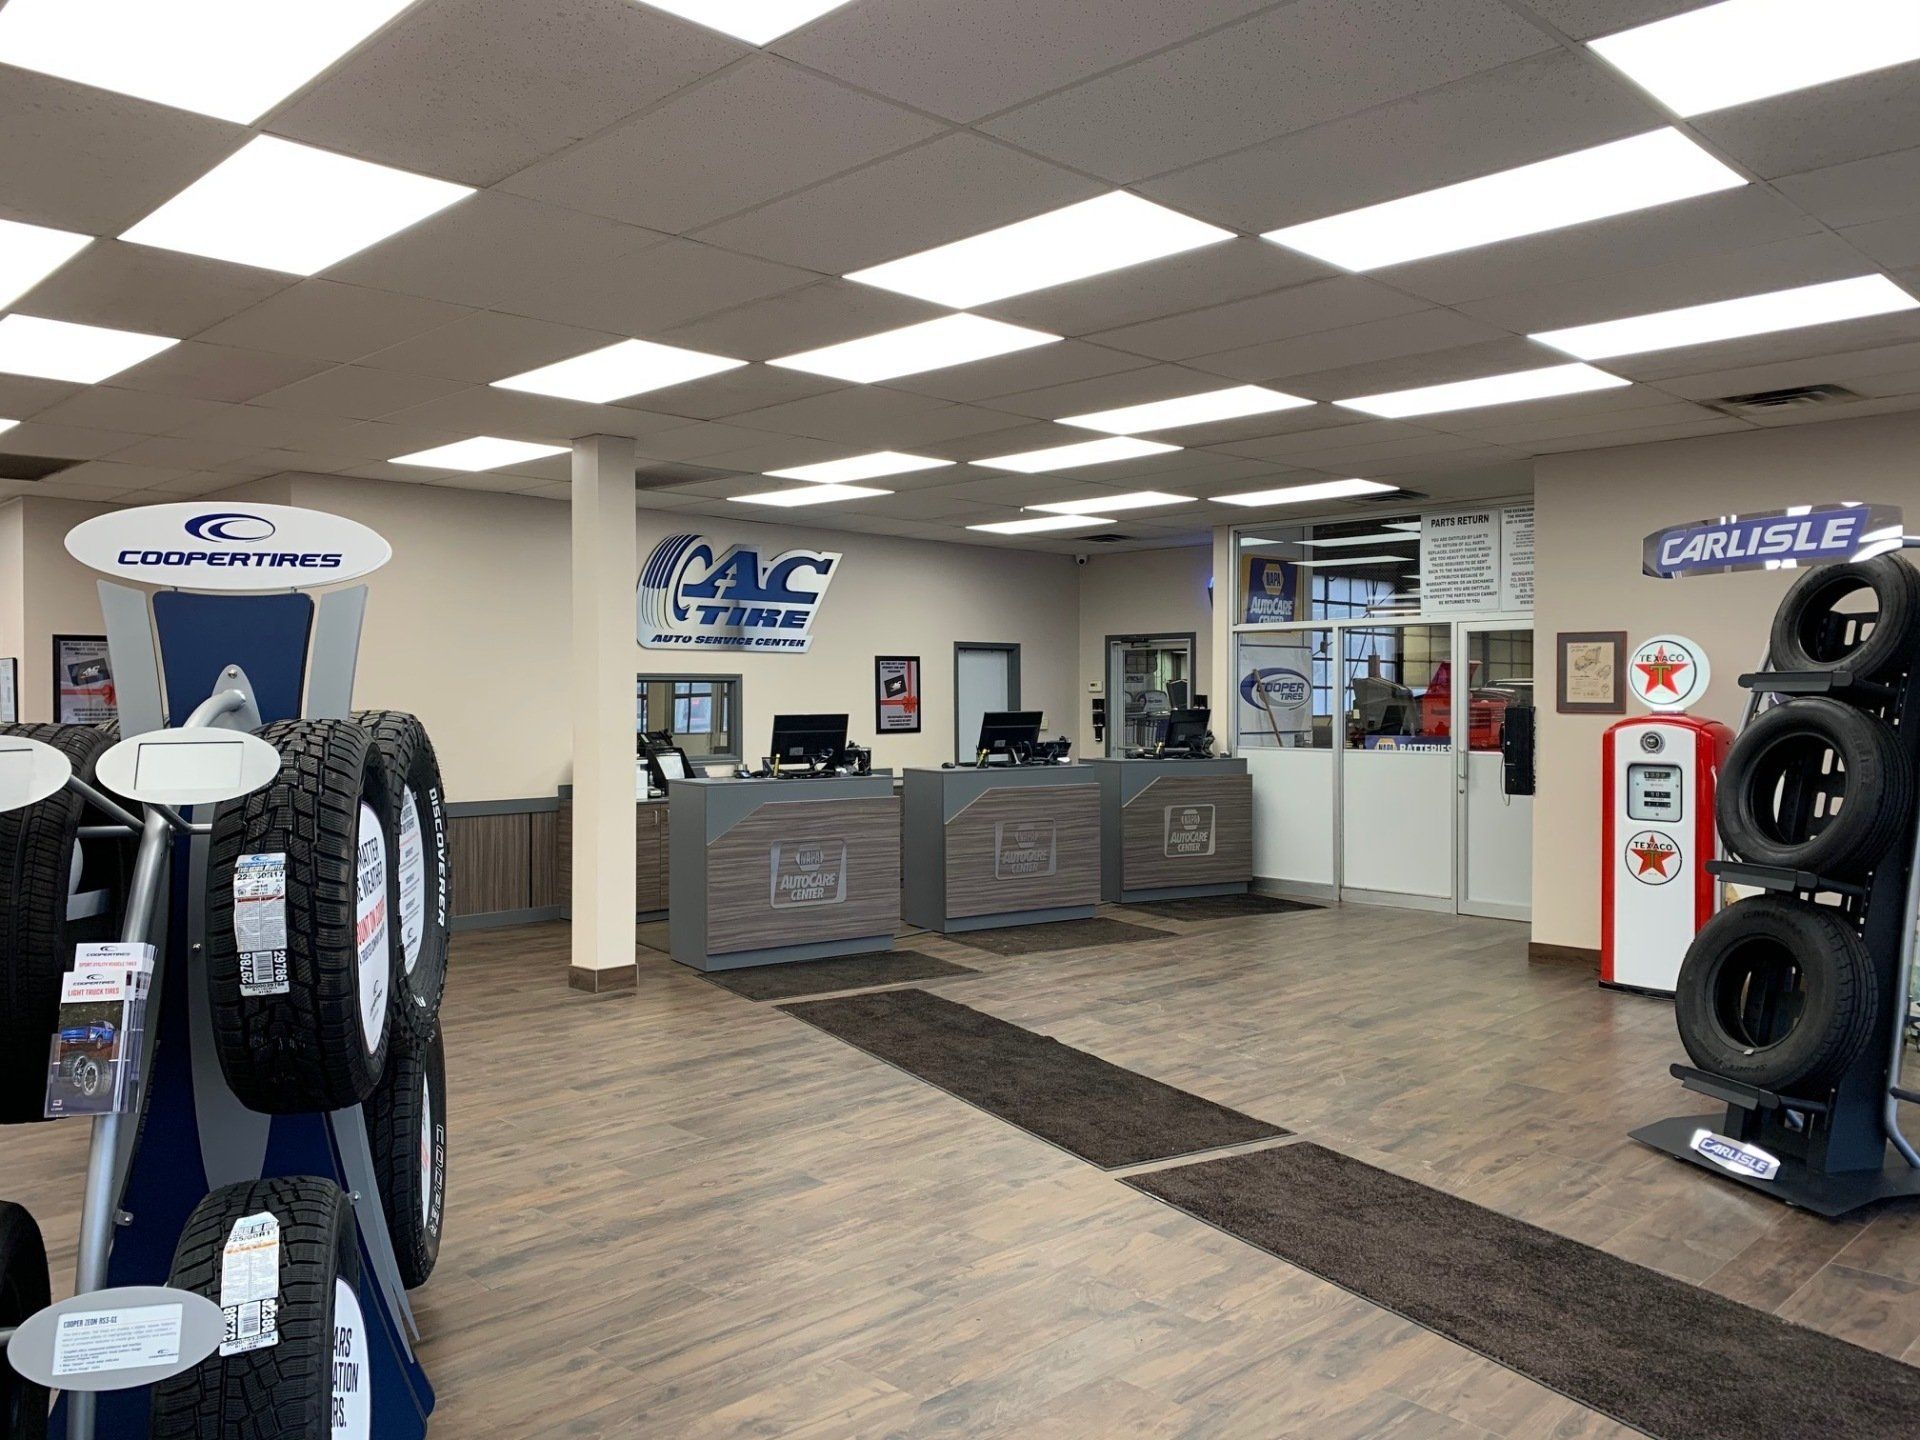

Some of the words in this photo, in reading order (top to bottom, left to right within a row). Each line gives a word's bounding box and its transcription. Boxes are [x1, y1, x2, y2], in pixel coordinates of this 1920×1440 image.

[1431, 518, 1455, 528] PARTS
[1458, 514, 1489, 525] RETURN
[1661, 517, 1857, 566] CARLISLE
[117, 550, 343, 568] COOPERTIRES
[1265, 572, 1281, 586] NAPA
[1250, 596, 1293, 615] AUTOCARE
[696, 605, 810, 628] TIRE
[650, 634, 692, 643] AUTO
[695, 636, 753, 646] SERVICE
[755, 638, 806, 647] CENTER
[1640, 654, 1684, 662] TEXACO
[1256, 682, 1305, 692] COOPER
[1170, 831, 1208, 843] AUTOCARE
[1634, 842, 1673, 850] TEXACO
[1178, 843, 1200, 852] CENTER
[429, 787, 446, 927] DISCOVERER
[801, 851, 821, 864] NAPA
[780, 873, 836, 889] AUTOCARE
[791, 888, 824, 900] CENTER
[240, 952, 253, 984] 29786
[274, 950, 287, 982] 29786
[1700, 1140, 1768, 1172] CARLISLE
[428, 1123, 444, 1237] COOPER
[64, 1319, 83, 1329] COOPER
[84, 1318, 97, 1326] ZEON
[223, 1306, 237, 1342] 32388
[334, 1326, 352, 1358] ARS
[332, 1362, 358, 1393] ATION
[332, 1397, 346, 1428] RS.
